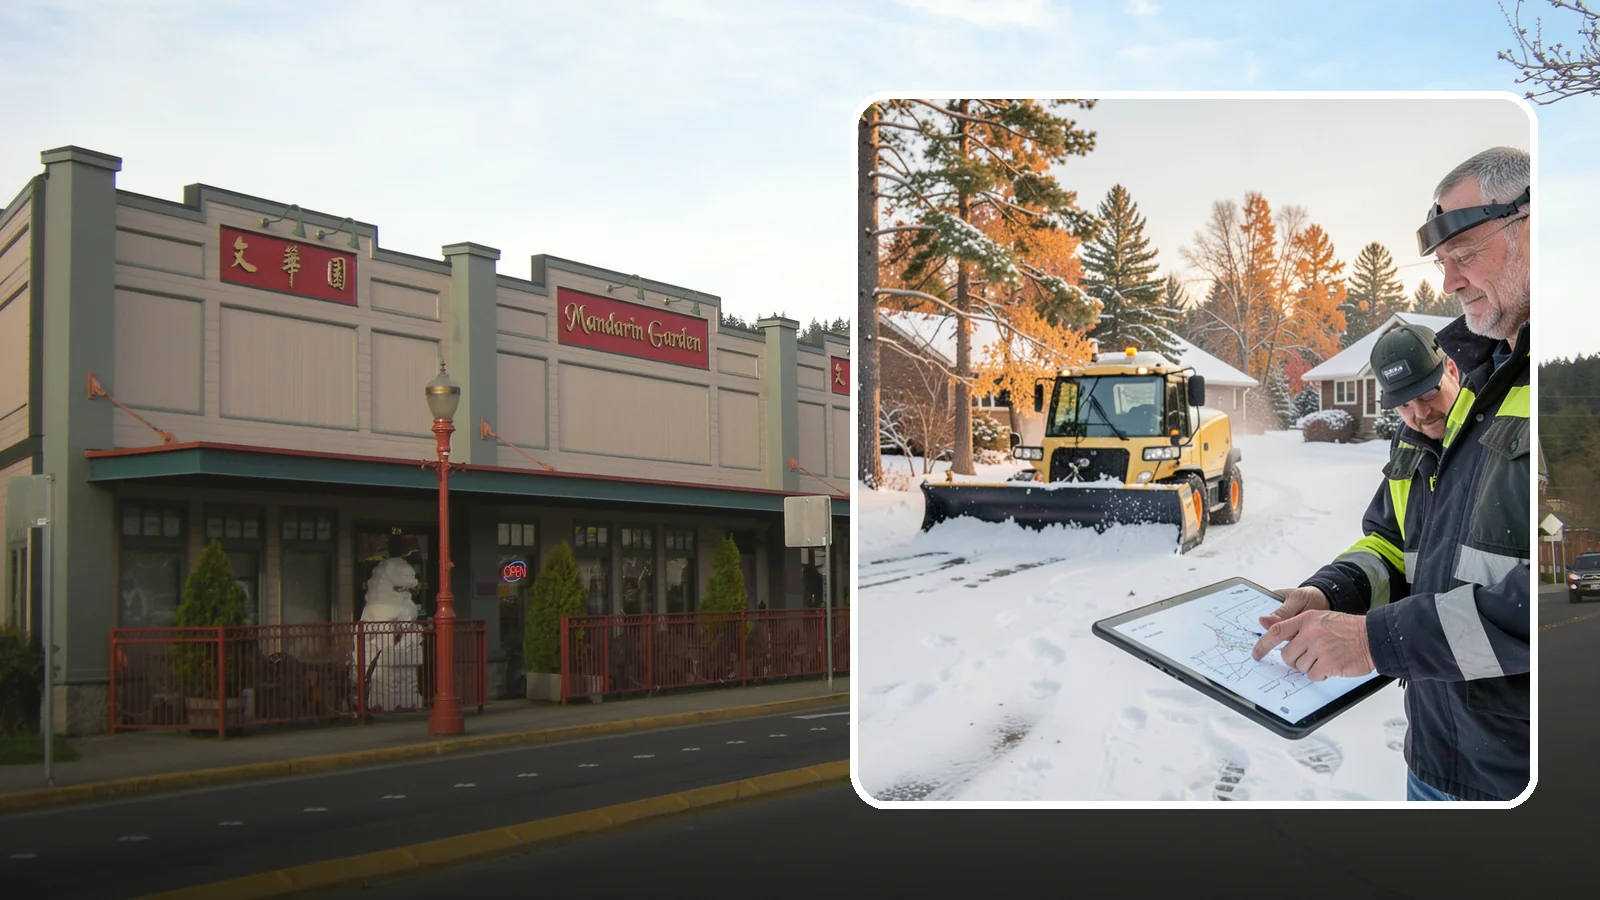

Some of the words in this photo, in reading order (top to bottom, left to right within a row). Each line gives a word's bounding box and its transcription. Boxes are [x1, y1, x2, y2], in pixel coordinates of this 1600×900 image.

[231, 235, 346, 291] 文華園
[564, 302, 644, 341] Mandarin
[647, 320, 702, 352] Garden
[503, 565, 527, 578] OPEN
